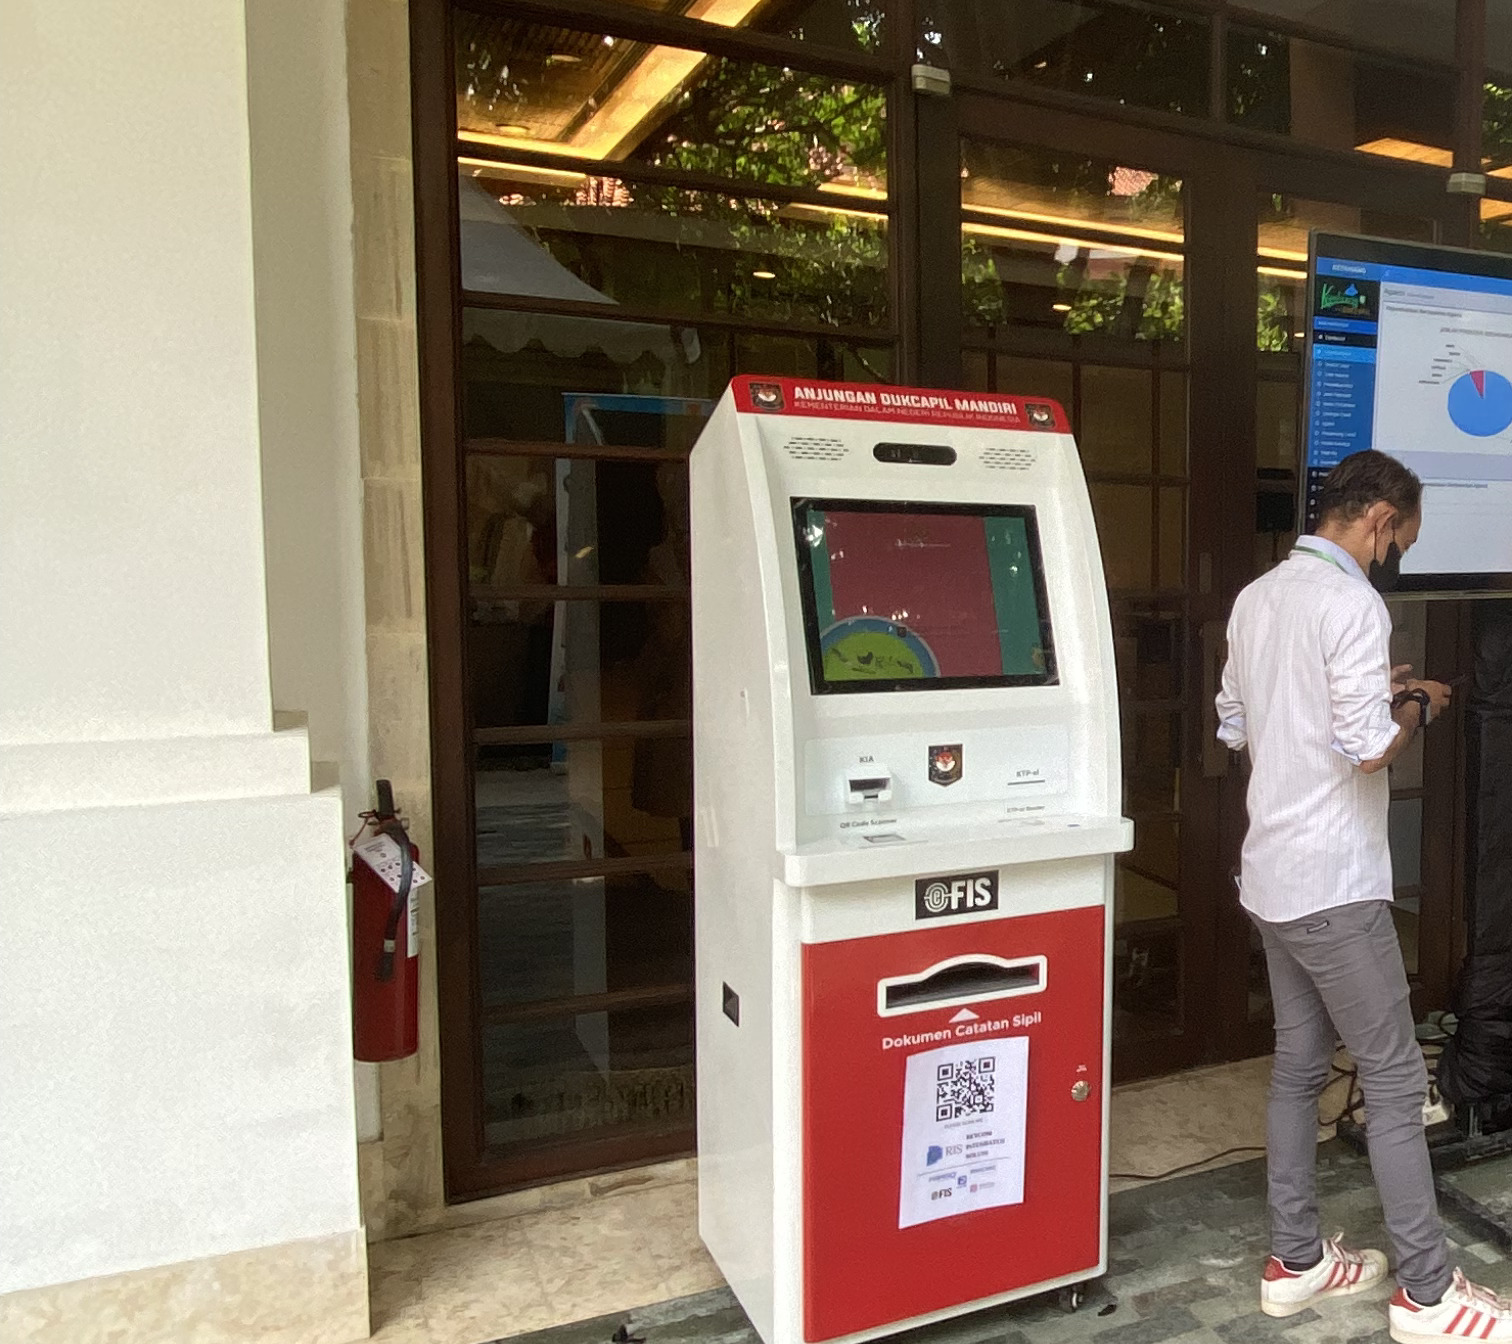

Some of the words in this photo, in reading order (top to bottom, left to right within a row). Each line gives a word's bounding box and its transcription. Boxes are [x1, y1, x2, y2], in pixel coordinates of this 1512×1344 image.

[794, 386, 876, 404] ANJUNGAN
[880, 393, 953, 410] DUKCAPIL
[954, 399, 1017, 414] MANDIRI
[864, 405, 896, 415] DALAM
[859, 755, 874, 763] KIA
[882, 1027, 952, 1050] Dokumen
[955, 1018, 1009, 1036] Catatan
[1012, 1011, 1042, 1028] Sipil
[945, 1144, 963, 1157] RIS
